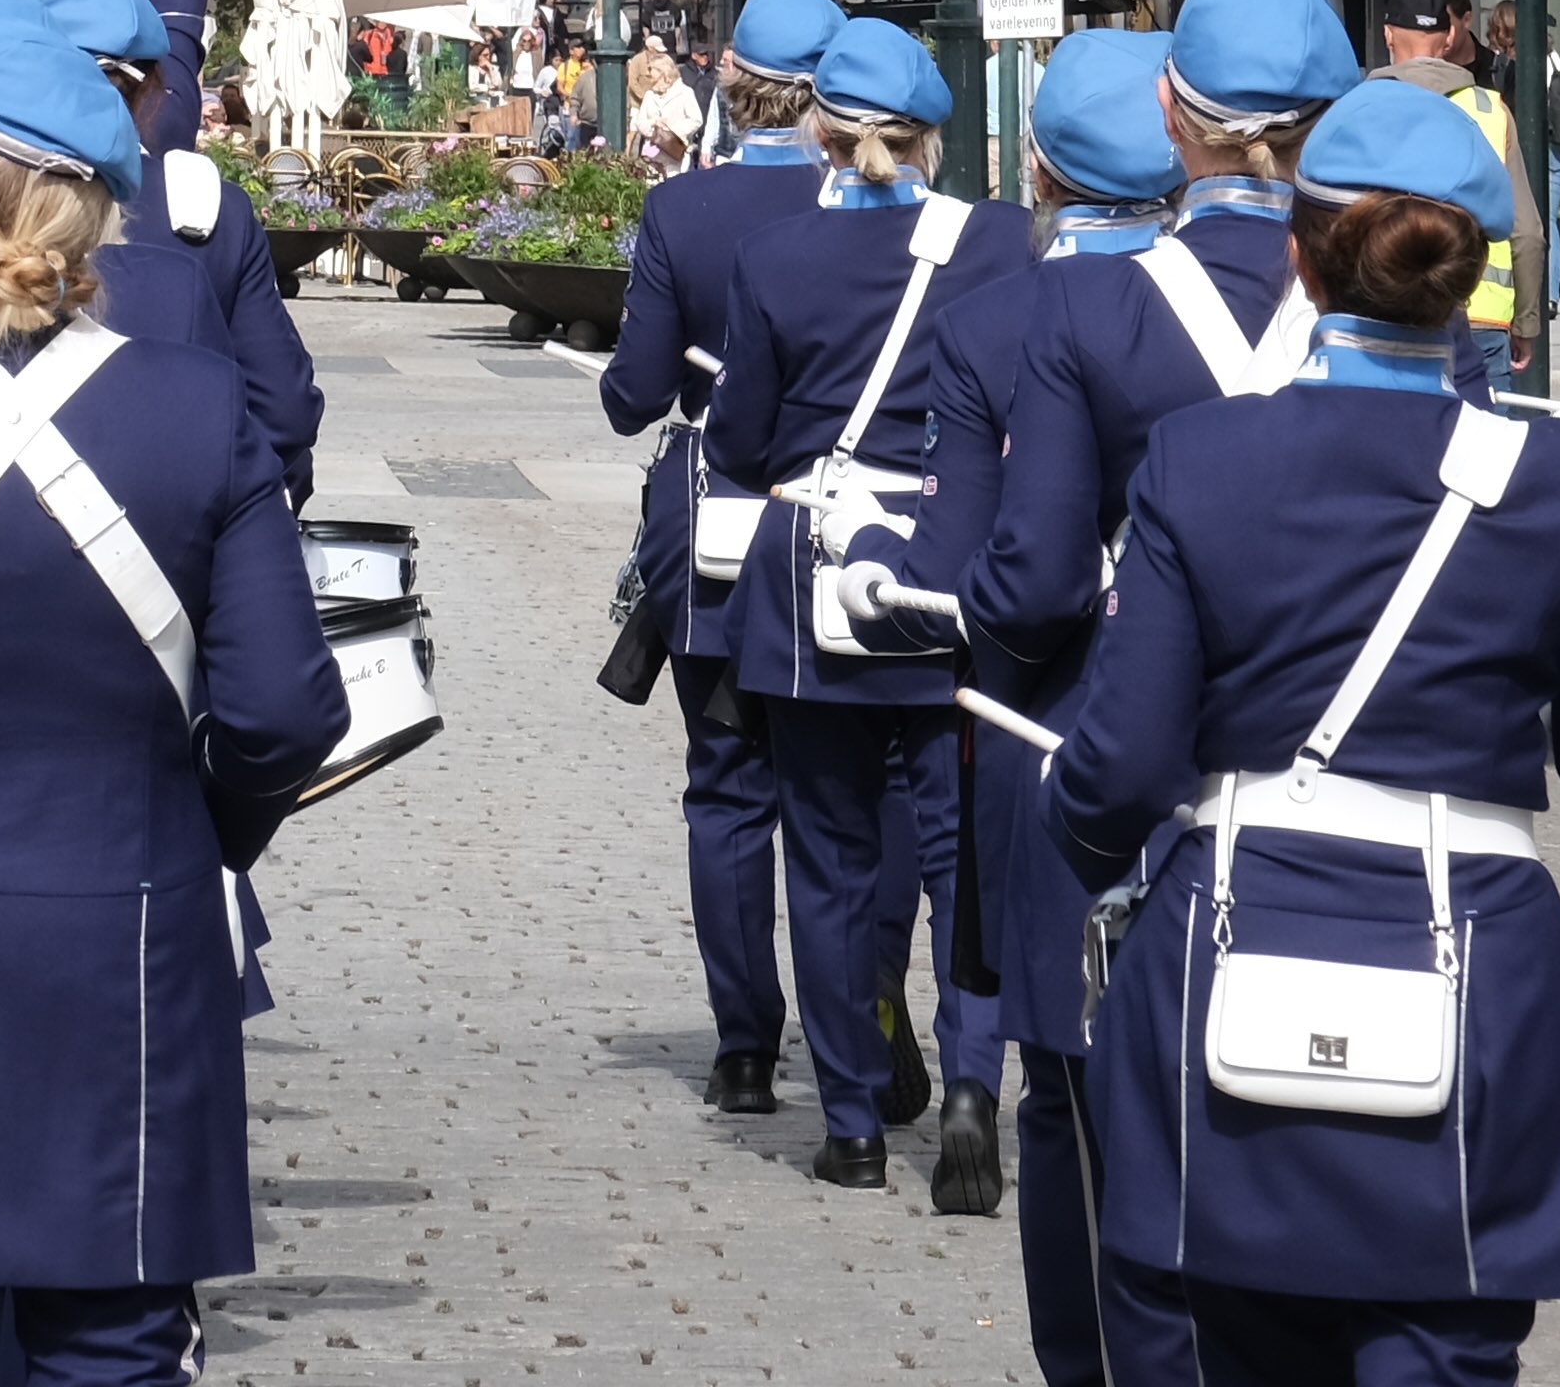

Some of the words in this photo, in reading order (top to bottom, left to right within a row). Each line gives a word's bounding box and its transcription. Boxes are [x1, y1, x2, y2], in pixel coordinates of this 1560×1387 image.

[990, 15, 1056, 30] varelevering
[315, 569, 350, 590] Bente
[351, 557, 369, 574] T.
[343, 664, 373, 686] enche
